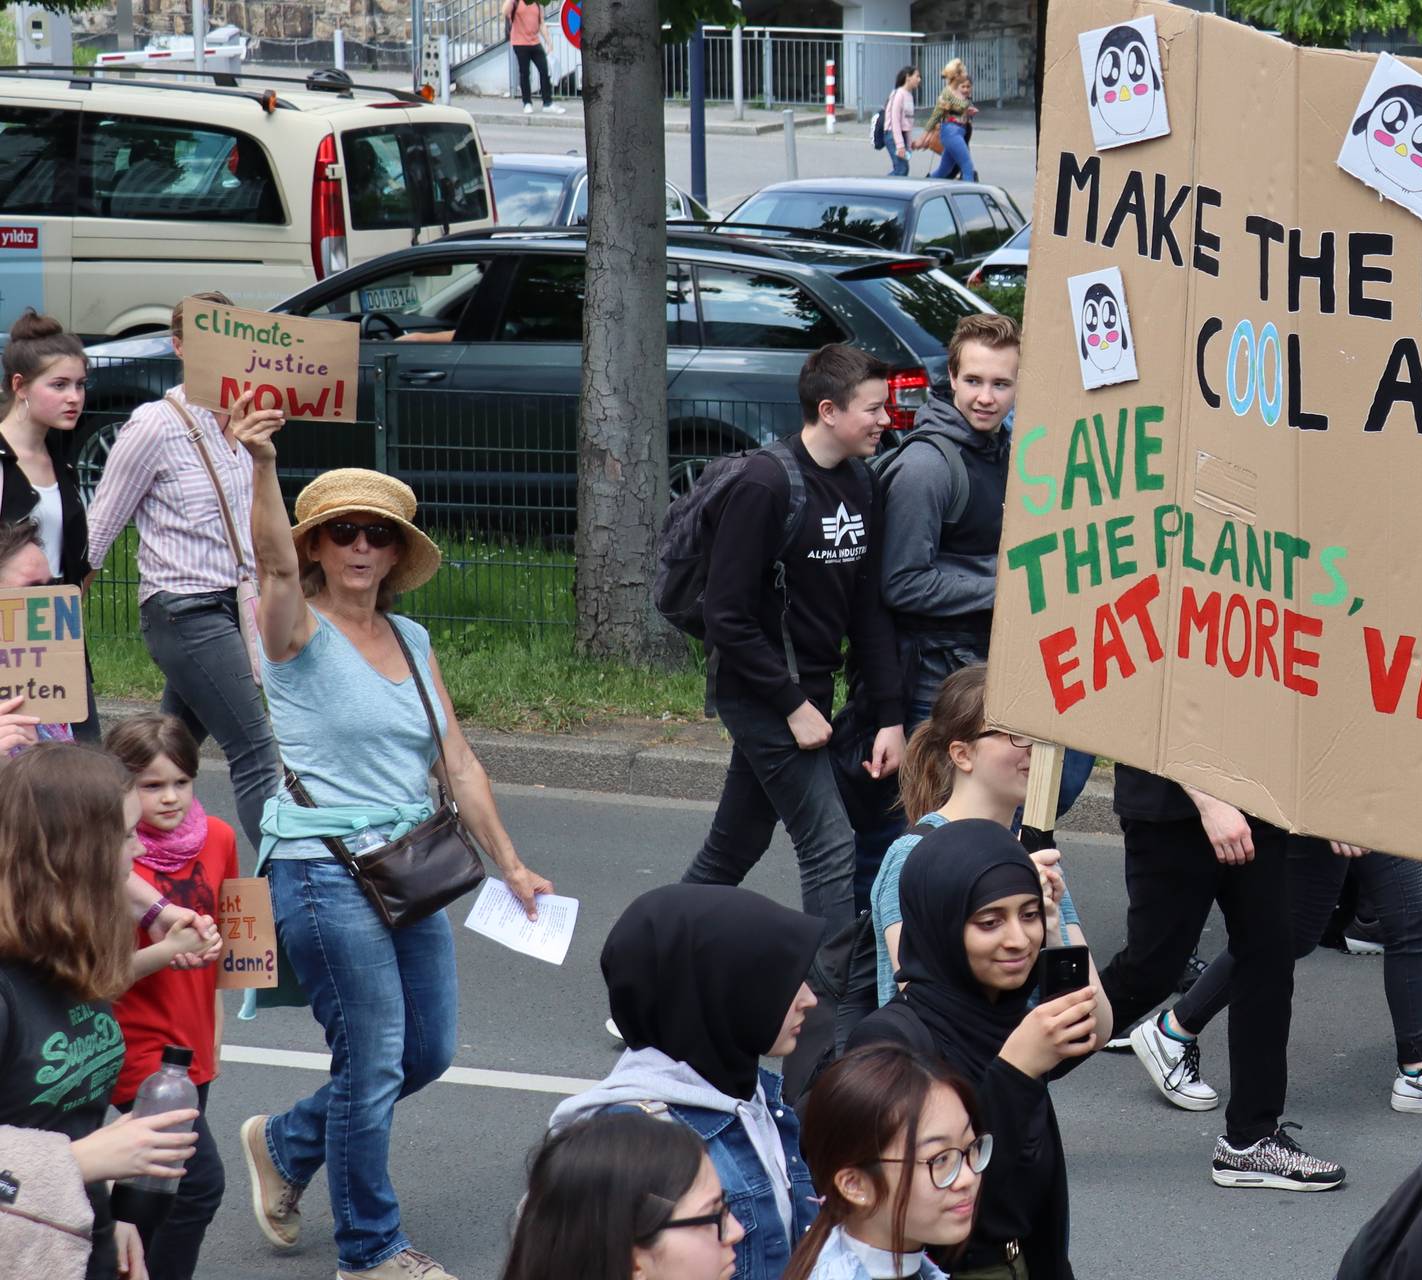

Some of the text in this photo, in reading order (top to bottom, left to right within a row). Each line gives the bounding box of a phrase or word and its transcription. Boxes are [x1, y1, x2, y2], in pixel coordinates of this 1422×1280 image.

[1053, 151, 1222, 277] MAKE
[1245, 215, 1393, 320] THE
[195, 310, 304, 347] climate-
[245, 350, 329, 376] justice
[1196, 316, 1328, 431] COOL
[220, 376, 345, 417] NOW!
[1015, 405, 1165, 516] SAVE
[807, 550, 838, 559] ALPHA
[1007, 504, 1364, 616] THE PLANTS,
[1039, 573, 1165, 714] EAT
[1177, 586, 1323, 697] MORE
[224, 949, 274, 980] dann?
[68, 1003, 96, 1026] REAL
